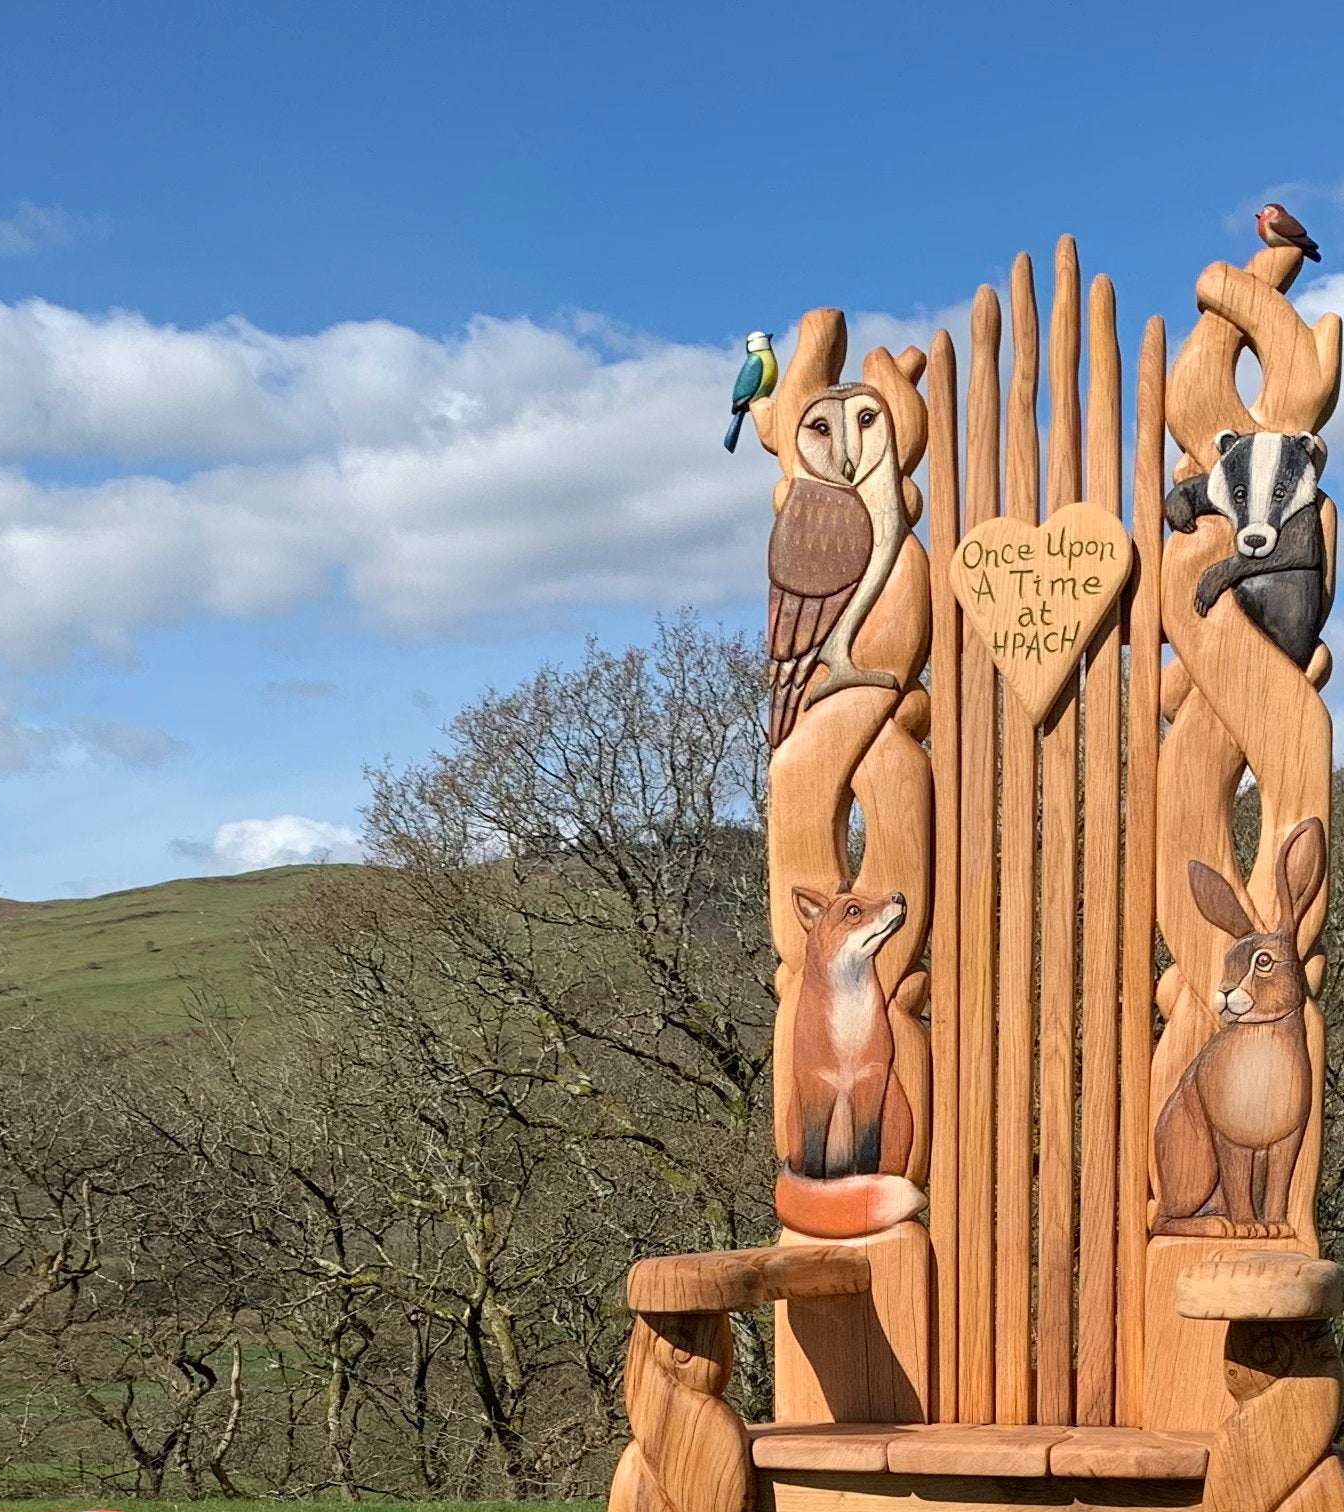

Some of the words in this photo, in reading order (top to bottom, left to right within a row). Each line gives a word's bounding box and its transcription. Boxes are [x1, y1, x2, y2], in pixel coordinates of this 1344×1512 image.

[962, 540, 1035, 570] Once
[1047, 527, 1116, 570] Upon
[971, 571, 995, 605] A
[1009, 570, 1103, 600] Time
[1018, 601, 1054, 627] at
[993, 621, 1081, 666] HPACH
